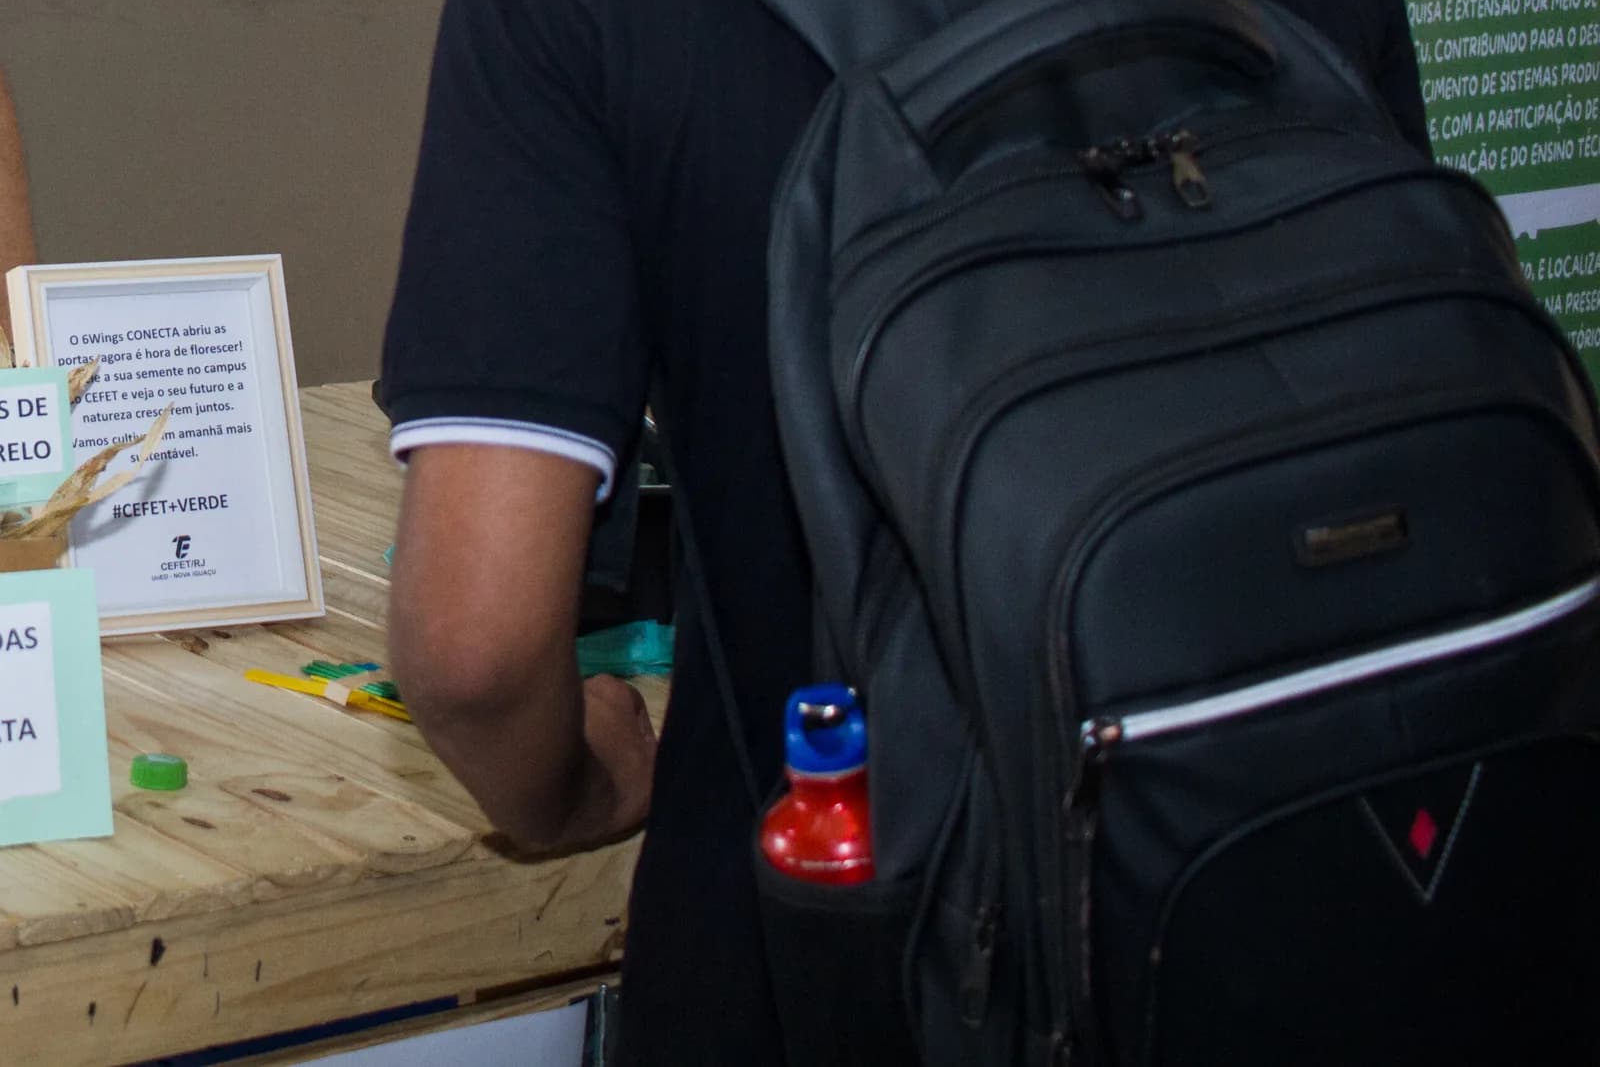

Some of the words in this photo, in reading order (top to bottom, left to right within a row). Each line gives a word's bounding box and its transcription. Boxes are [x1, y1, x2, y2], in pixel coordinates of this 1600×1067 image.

[1407, 0, 1442, 27] QUISA
[1445, 0, 1453, 22] E
[1434, 32, 1527, 62] CONTRIBUINDO
[1530, 27, 1564, 51] PARA
[1568, 26, 1577, 47] O
[1422, 75, 1478, 103] CIMENTO
[1481, 71, 1497, 95] DE
[1500, 65, 1558, 92] SISTEMAS
[1561, 61, 1600, 86] PRODU
[1442, 111, 1472, 140] COM
[1475, 112, 1485, 133] A
[1488, 94, 1582, 134] PARTICIPAÇÃO
[1585, 97, 1599, 121] DE
[1500, 146, 1508, 169] E
[1511, 144, 1527, 168] DO
[1531, 139, 1574, 165] ENSINO
[1578, 127, 1600, 158] TÉC
[69, 335, 79, 345] O
[82, 332, 124, 345] 6Wings
[126, 327, 180, 341] CONECTA
[183, 324, 211, 336] abriu
[214, 325, 226, 334] as
[101, 352, 133, 364] agora
[135, 348, 142, 360] é
[145, 347, 171, 359] hora
[174, 345, 188, 356] de
[191, 340, 243, 355] florescer!
[104, 373, 110, 382] a
[113, 372, 133, 381] sua
[135, 366, 184, 379] semente
[187, 365, 201, 375] no
[204, 362, 247, 374] campus
[84, 390, 118, 403] CEFET
[121, 391, 128, 400] e
[131, 387, 154, 400] veja
[157, 389, 164, 397] o
[168, 386, 187, 396] seu
[189, 383, 224, 394] futuro
[227, 382, 234, 391] e
[237, 381, 244, 390] a
[18, 397, 48, 417] DE
[83, 409, 132, 423] natureza
[135, 405, 192, 419] crescrem
[195, 402, 234, 415] juntos.
[179, 424, 223, 438] amanhã
[226, 422, 252, 434] mais
[113, 494, 229, 518] #CEFET+VERDE
[161, 558, 205, 571] CEFET/RJ
